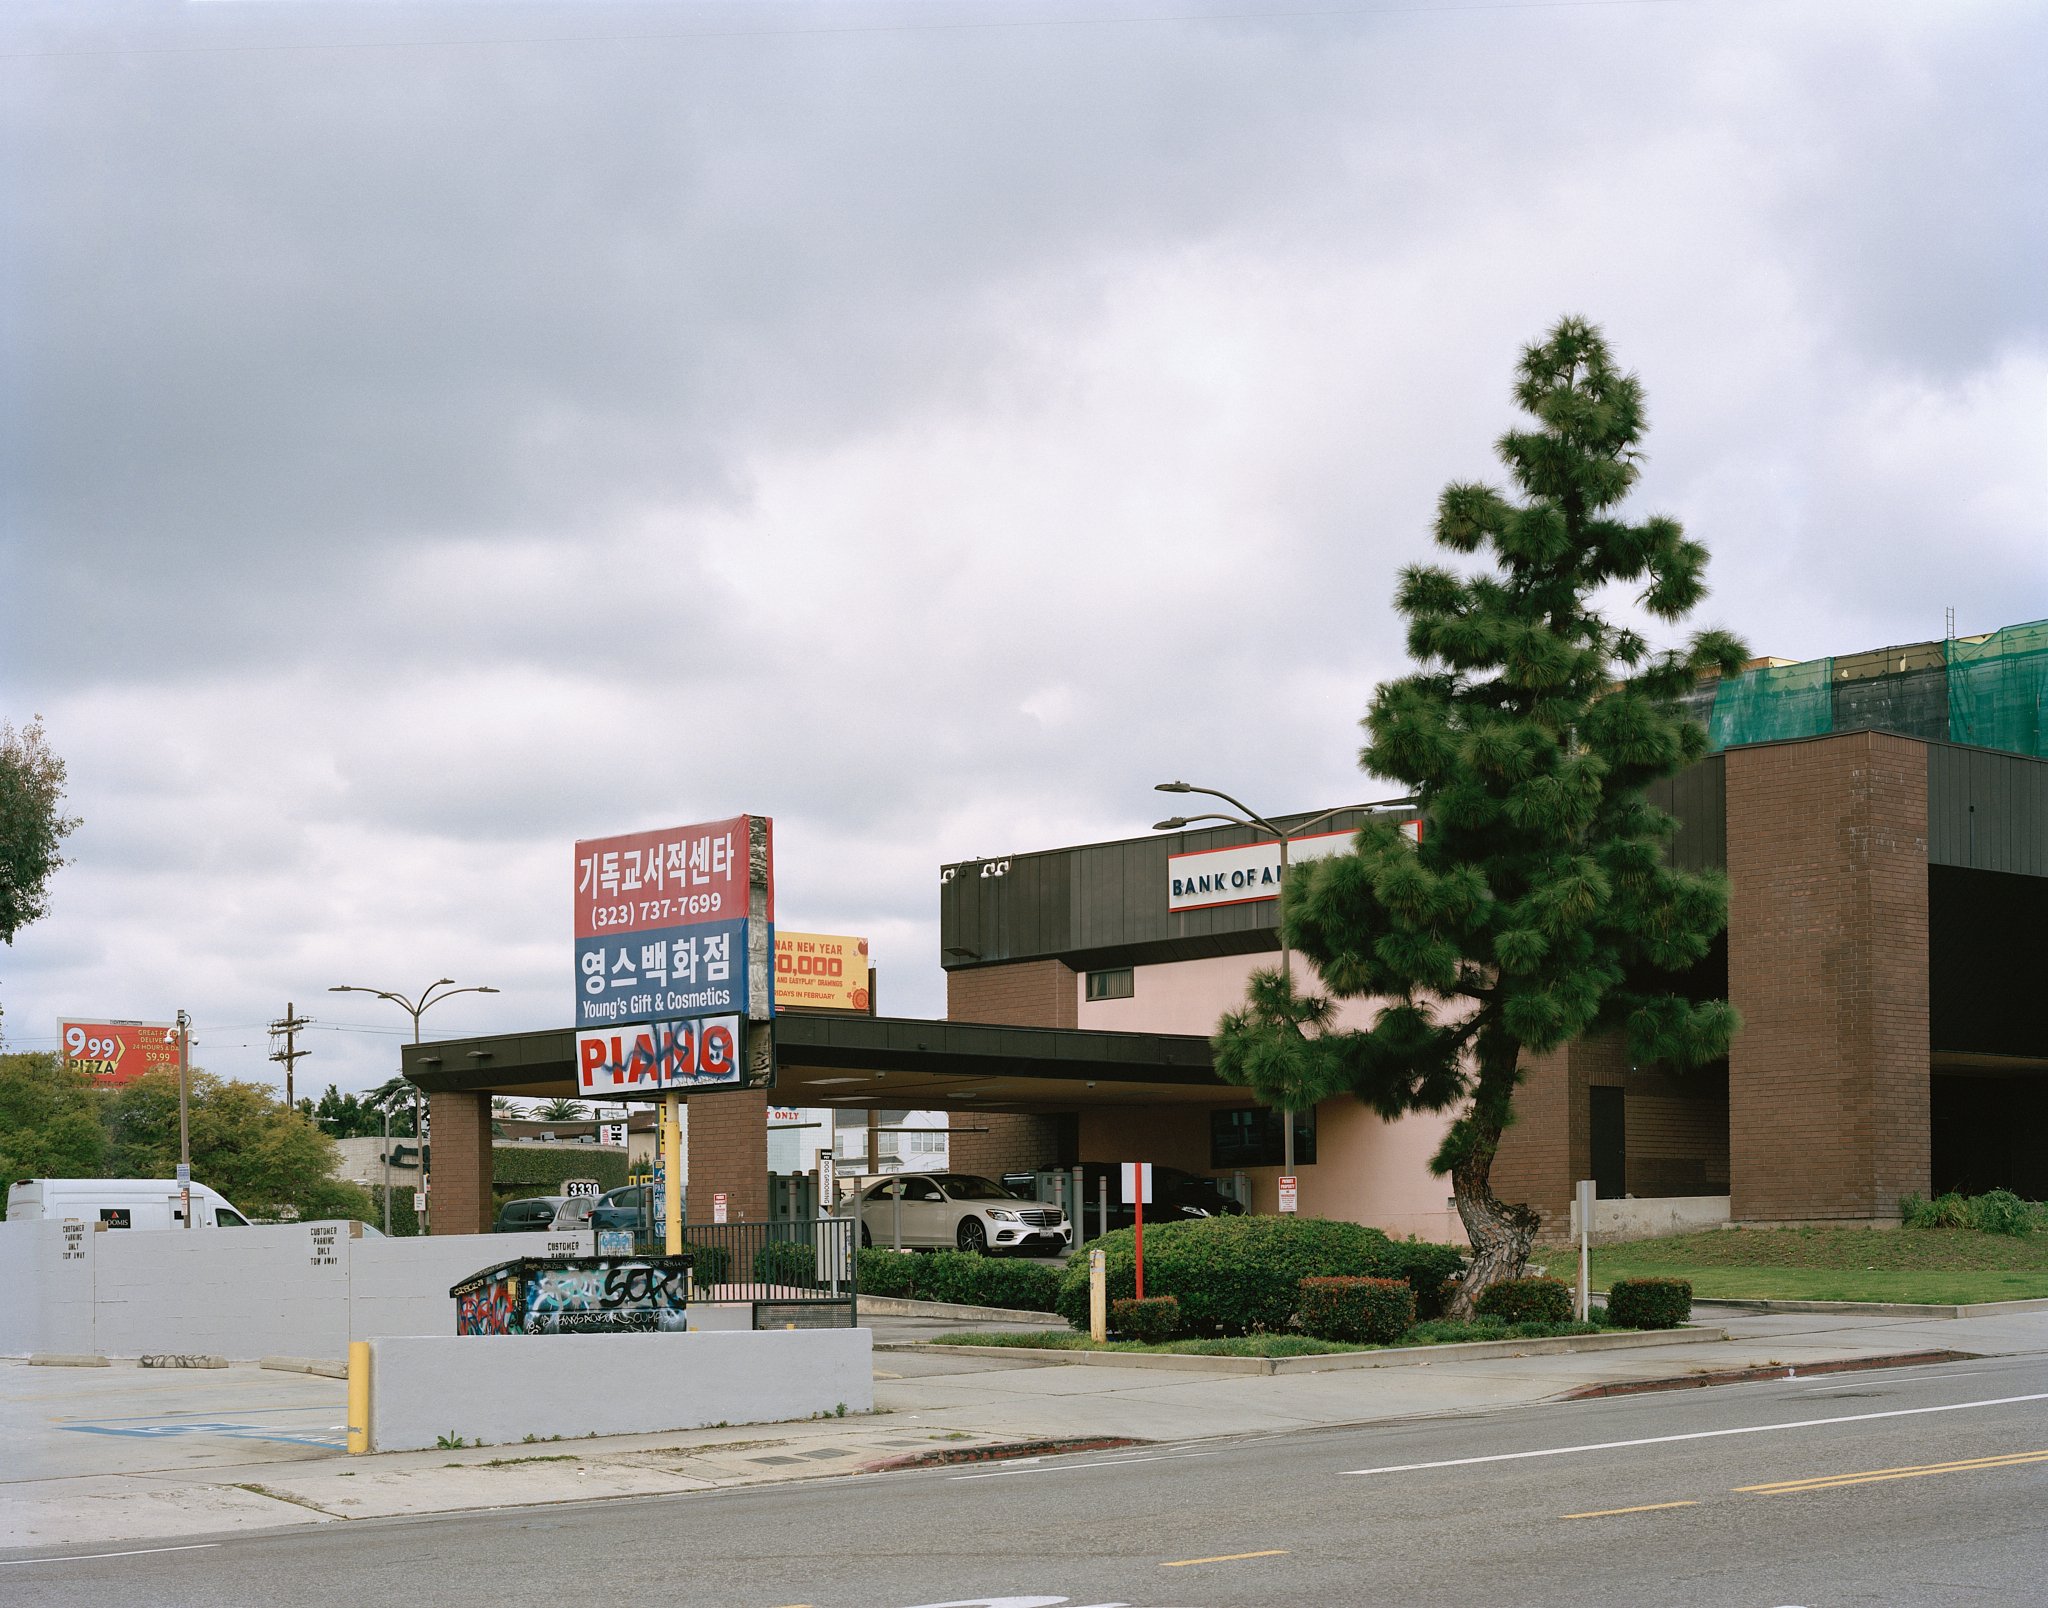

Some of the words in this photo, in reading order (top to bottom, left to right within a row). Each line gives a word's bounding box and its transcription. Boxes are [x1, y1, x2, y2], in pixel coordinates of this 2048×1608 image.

[579, 832, 735, 899] 기독교서적센타
[1172, 872, 1226, 897] BANK
[1231, 868, 1256, 888] OF
[591, 902, 635, 930] (323)
[639, 892, 722, 921] 737-7699
[797, 941, 815, 953] NEW
[819, 943, 842, 955] YEAR
[581, 932, 730, 994] 영스백화점
[774, 953, 842, 977] 0,000
[817, 979, 843, 987] DRAWINGS
[803, 991, 836, 1000] FEBRUARY
[583, 997, 628, 1020] Young's
[630, 994, 653, 1015] Gift
[654, 993, 665, 1012] &
[667, 987, 730, 1010] Cosmetics
[145, 1052, 170, 1061] $9.99
[580, 1025, 734, 1087] PIANO
[69, 1059, 116, 1075] PIZZA
[775, 1111, 800, 1120] ONLY
[569, 1182, 601, 1197] 3330
[62, 1224, 85, 1233] CUSTOMER
[310, 1226, 337, 1236] CUSTOMER
[64, 1233, 83, 1241] PARKING
[313, 1236, 335, 1245] PARKING
[68, 1242, 79, 1251] ONLY
[317, 1247, 330, 1255] ONLY
[547, 1241, 580, 1251] CUSTOMER
[62, 1252, 71, 1260] TOW
[73, 1251, 85, 1259] AWAY
[310, 1257, 321, 1266] TOW
[323, 1257, 338, 1265] AWAY
